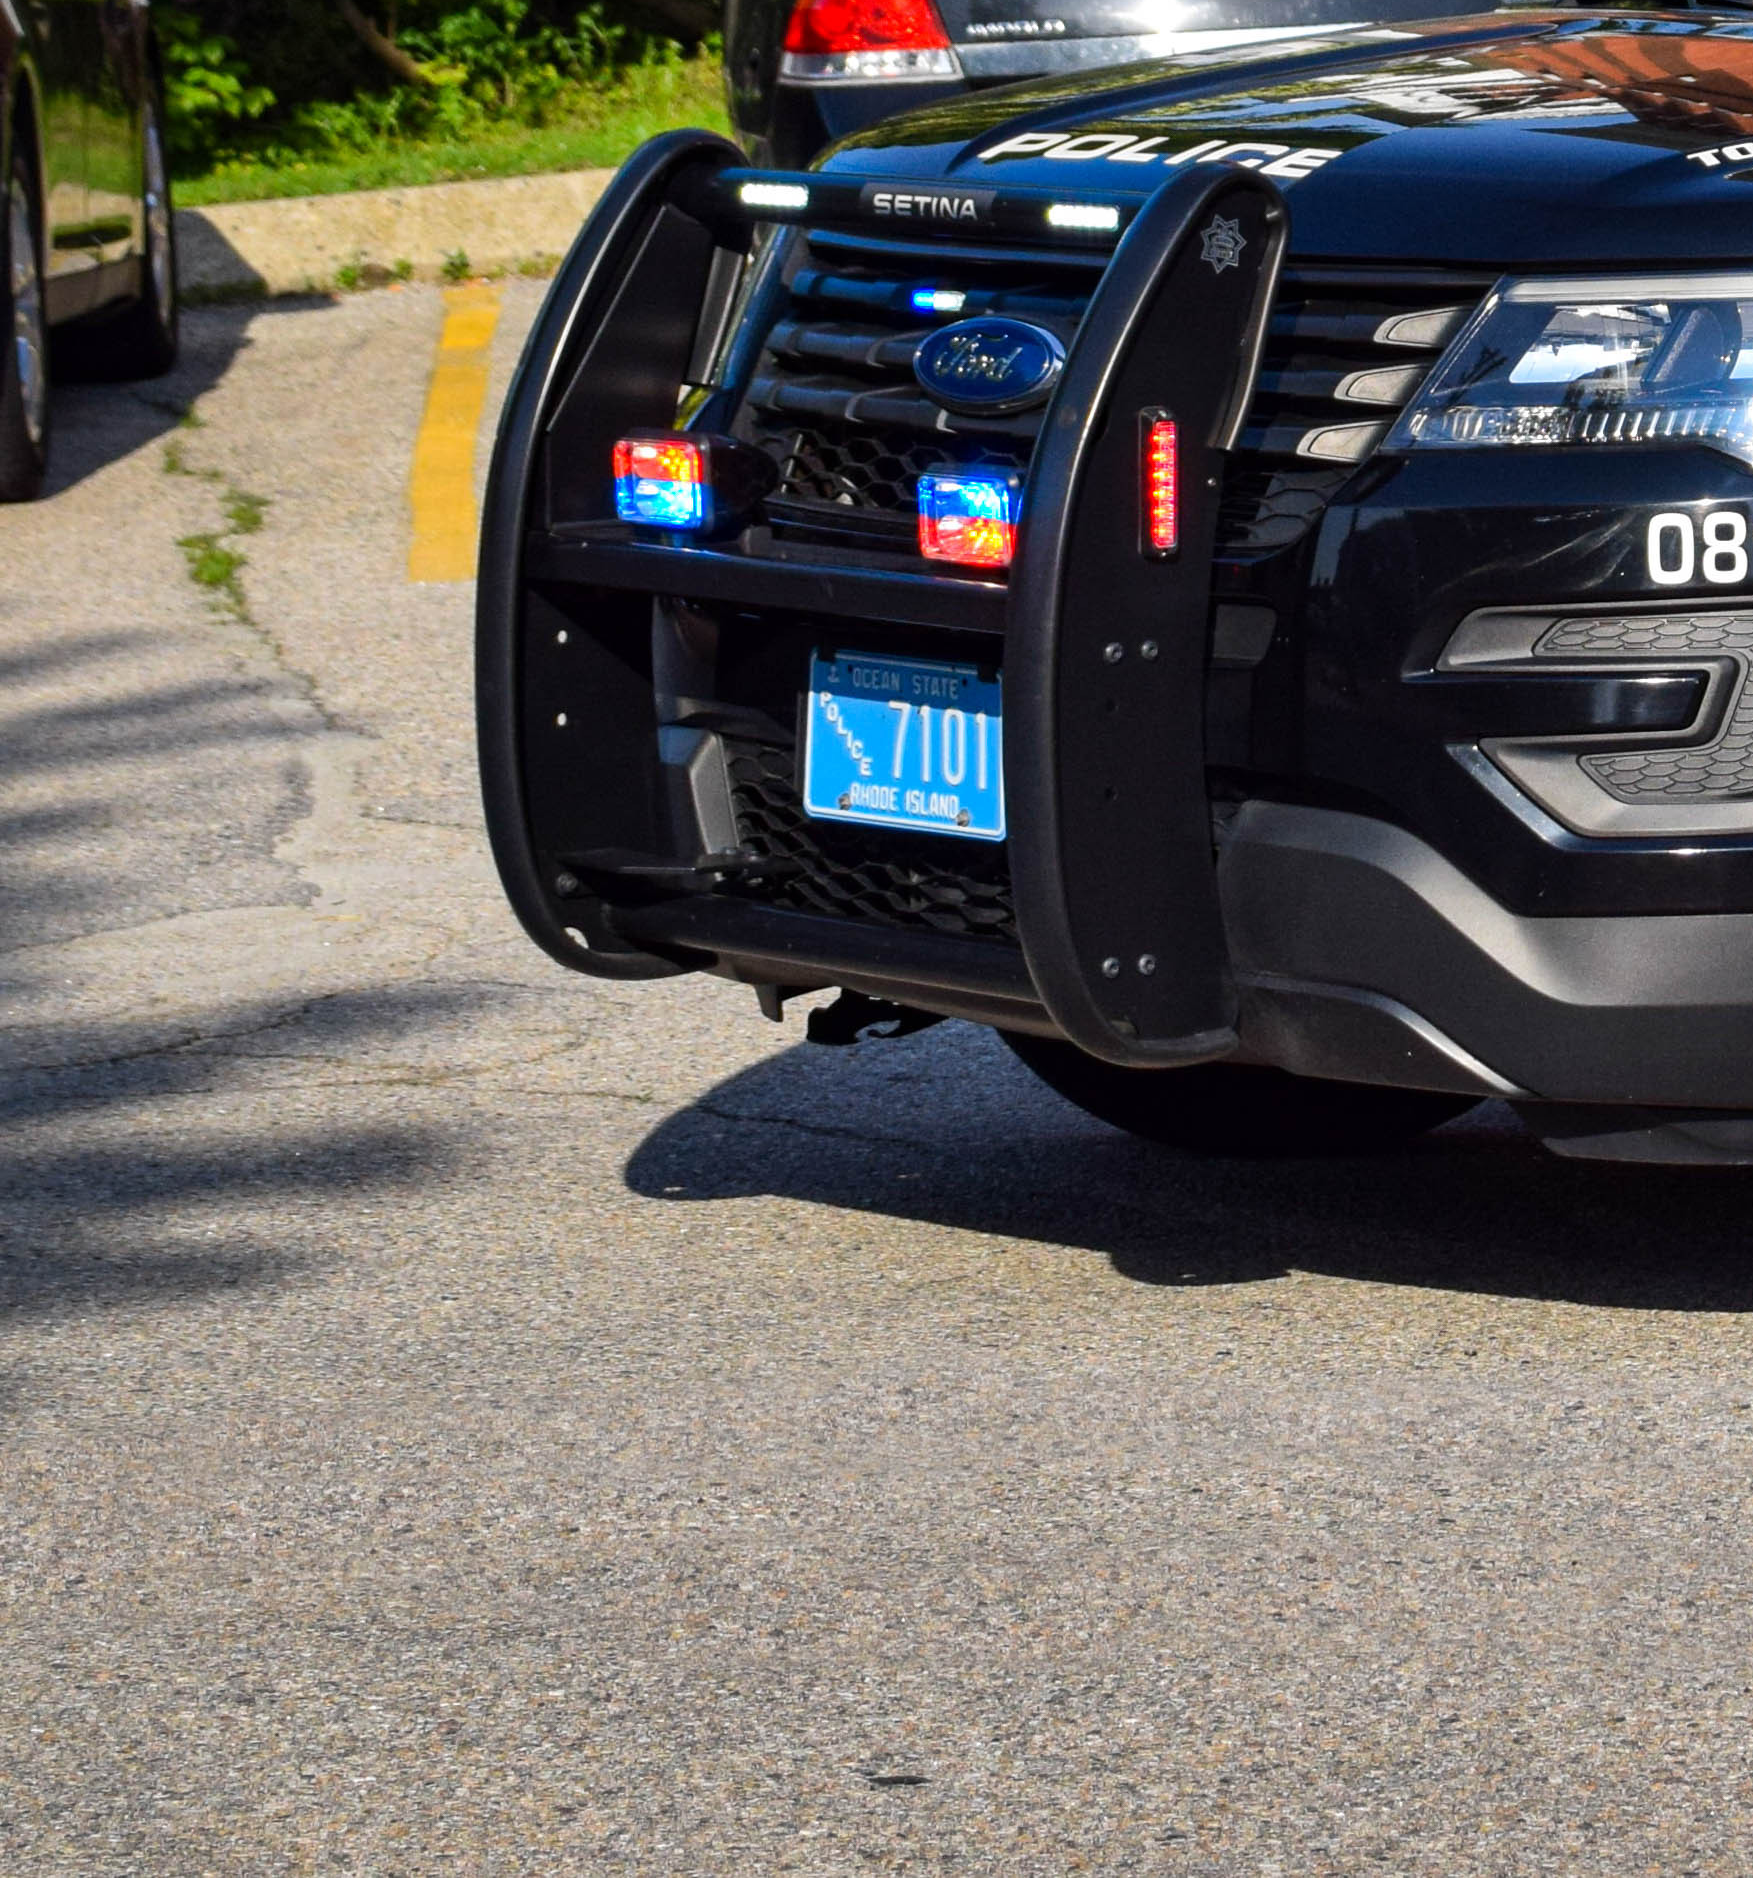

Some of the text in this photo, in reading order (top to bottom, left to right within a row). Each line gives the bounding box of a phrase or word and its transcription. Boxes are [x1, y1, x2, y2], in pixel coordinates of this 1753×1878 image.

[978, 132, 1343, 178] POLICE
[873, 193, 977, 220] SETINA
[936, 333, 1023, 381] Ford
[852, 668, 959, 700] OCEAN STATE
[819, 693, 873, 777] POLICE
[888, 700, 987, 790] 7101
[850, 782, 959, 819] RHODE ISLAND
